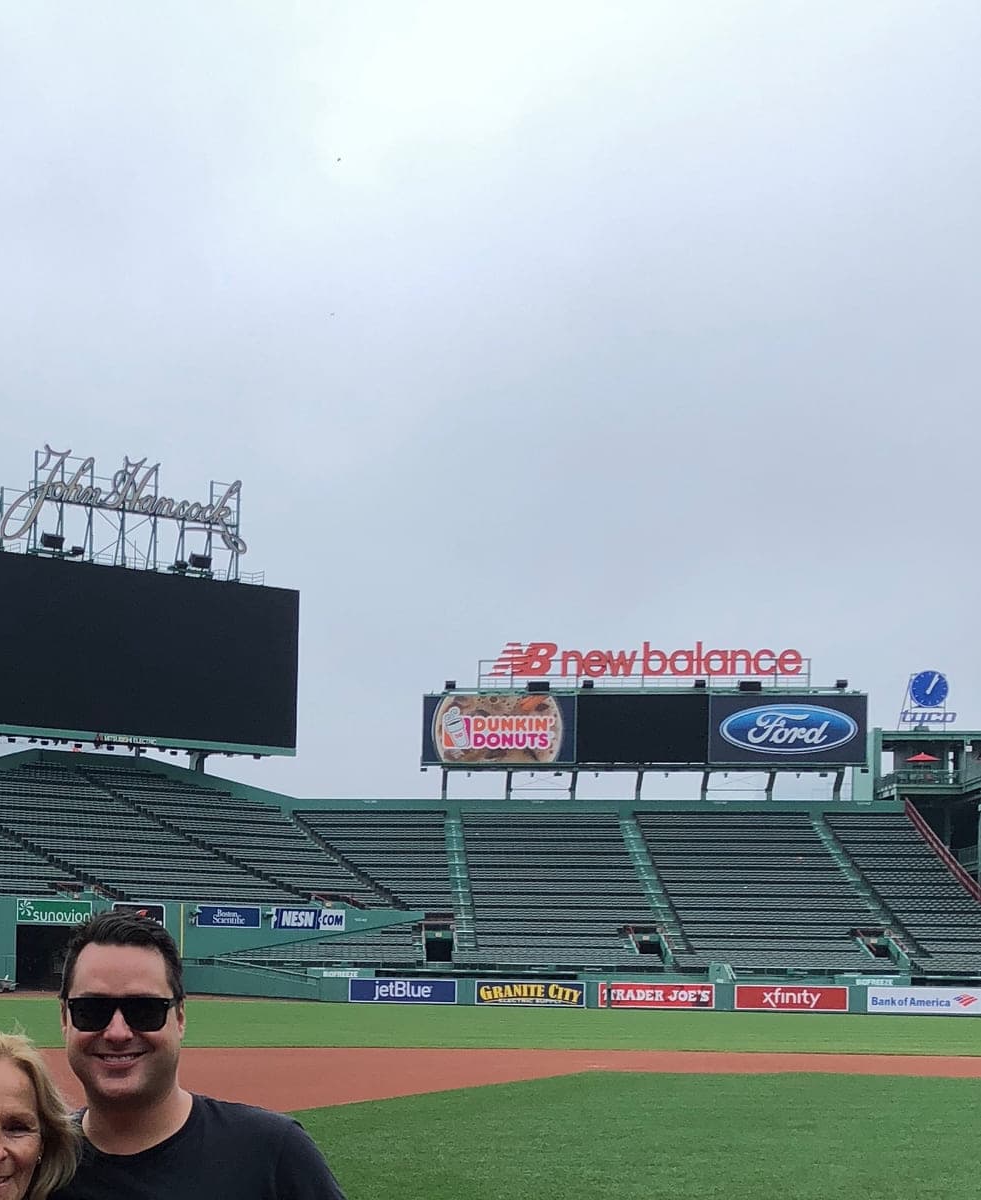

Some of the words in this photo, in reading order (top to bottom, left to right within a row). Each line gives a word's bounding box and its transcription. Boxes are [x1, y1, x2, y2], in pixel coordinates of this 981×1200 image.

[561, 648, 637, 677] new
[643, 641, 802, 676] balance
[473, 716, 554, 731] DUNKIN'
[747, 711, 830, 744] Ford
[473, 733, 549, 747] DONUTS
[32, 909, 91, 923] sunovion
[281, 911, 314, 928] NESN
[374, 981, 431, 1000] jetBlue
[480, 984, 545, 1000] GRANITE
[548, 983, 582, 1003] CITY
[668, 989, 711, 1003] JOE'S
[762, 987, 822, 1008] xfinity
[871, 997, 897, 1006] Bank
[898, 997, 909, 1006] of
[909, 997, 951, 1007] America
